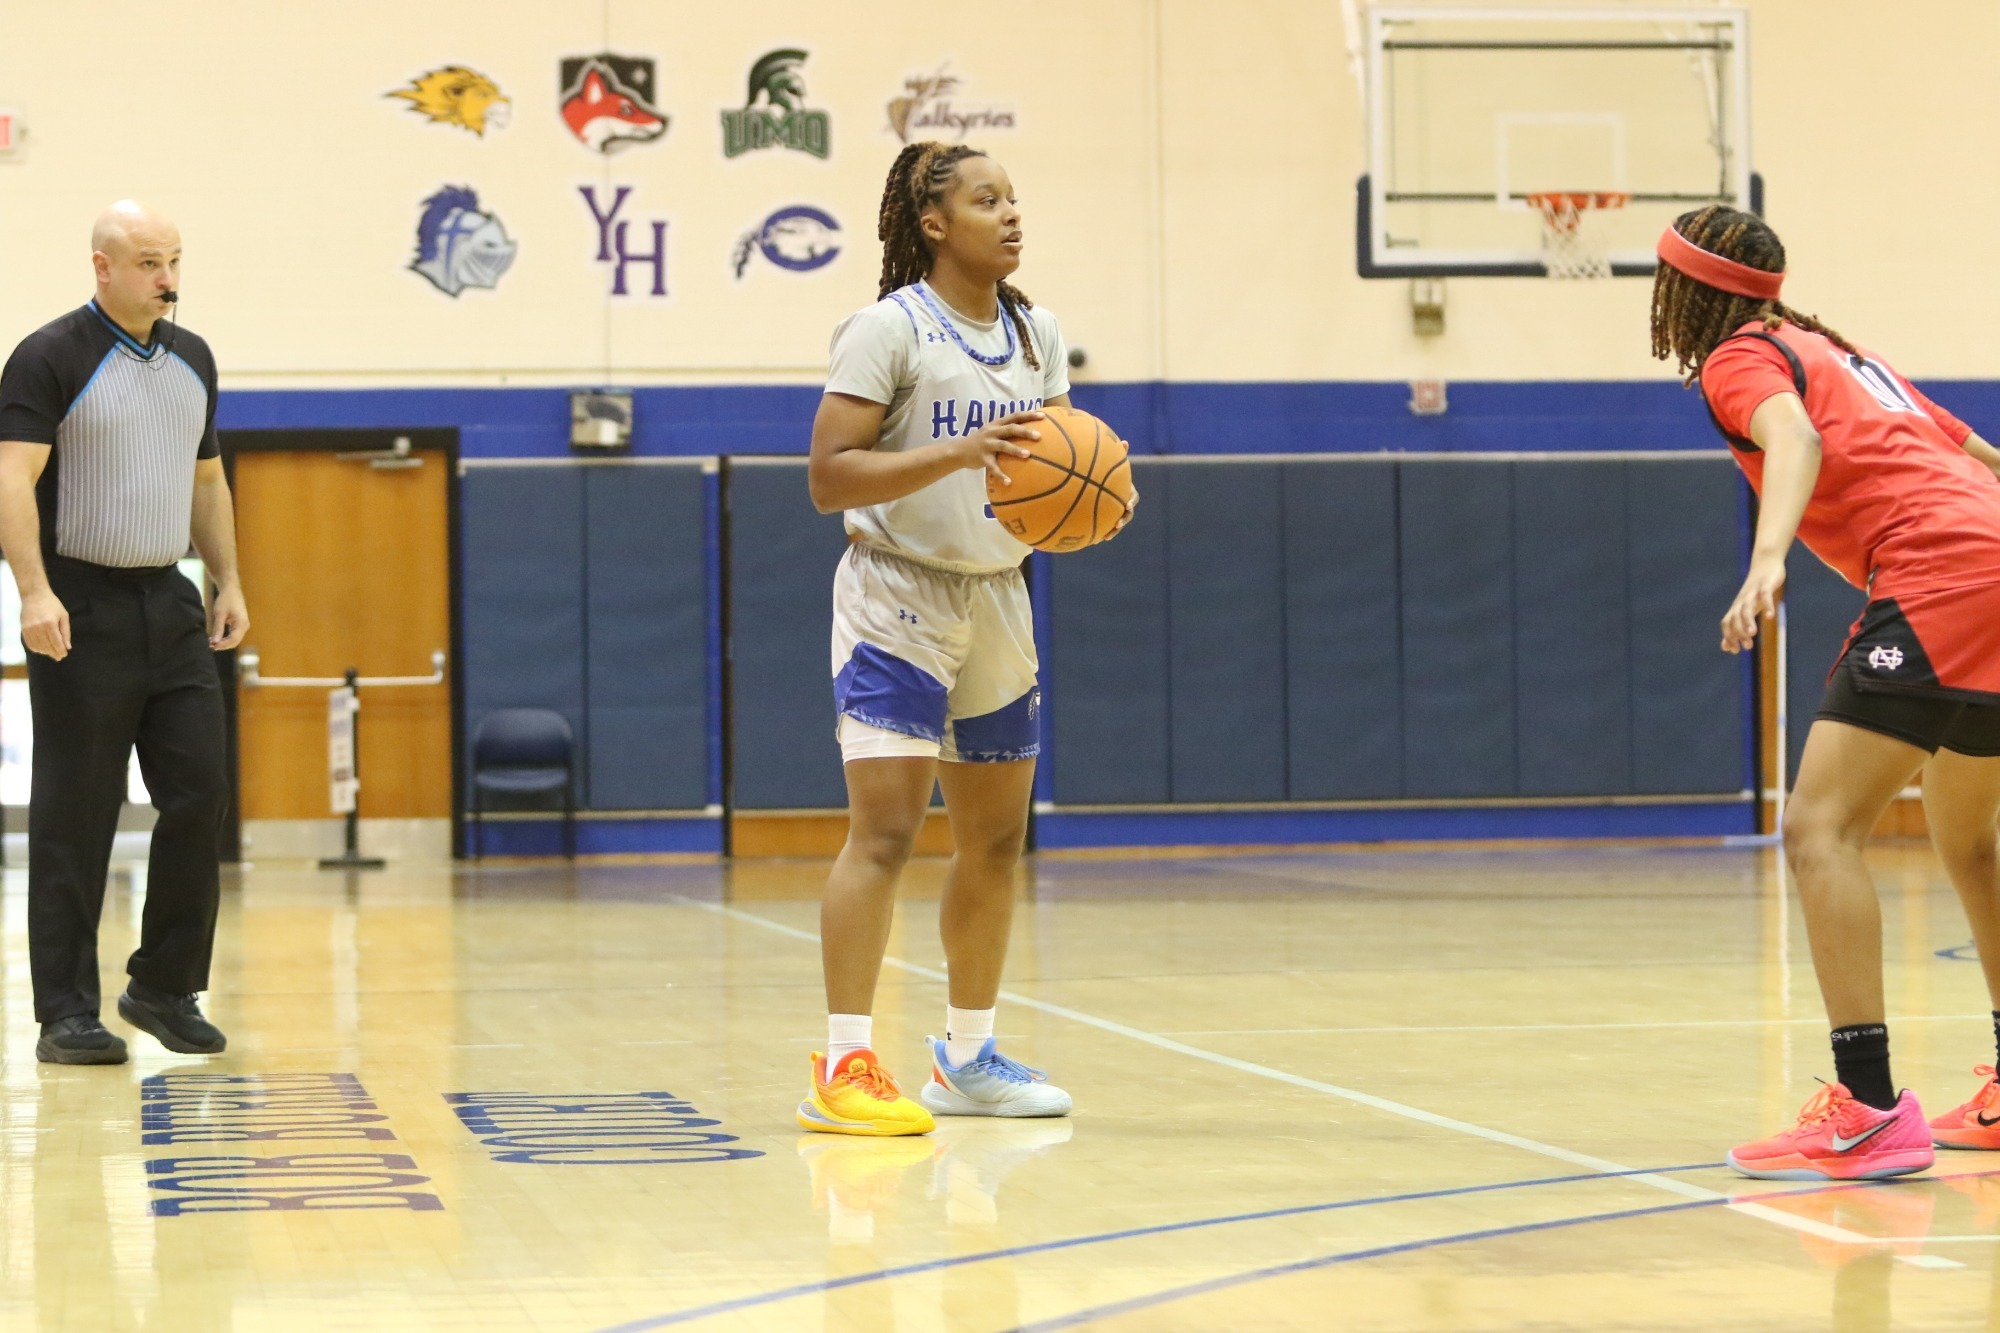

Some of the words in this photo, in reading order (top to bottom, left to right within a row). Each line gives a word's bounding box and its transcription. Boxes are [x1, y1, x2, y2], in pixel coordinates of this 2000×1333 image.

[578, 186, 668, 295] YH
[141, 1072, 398, 1145] BURKE
[441, 1091, 767, 1165] COURT
[145, 1153, 446, 1217] BOB
